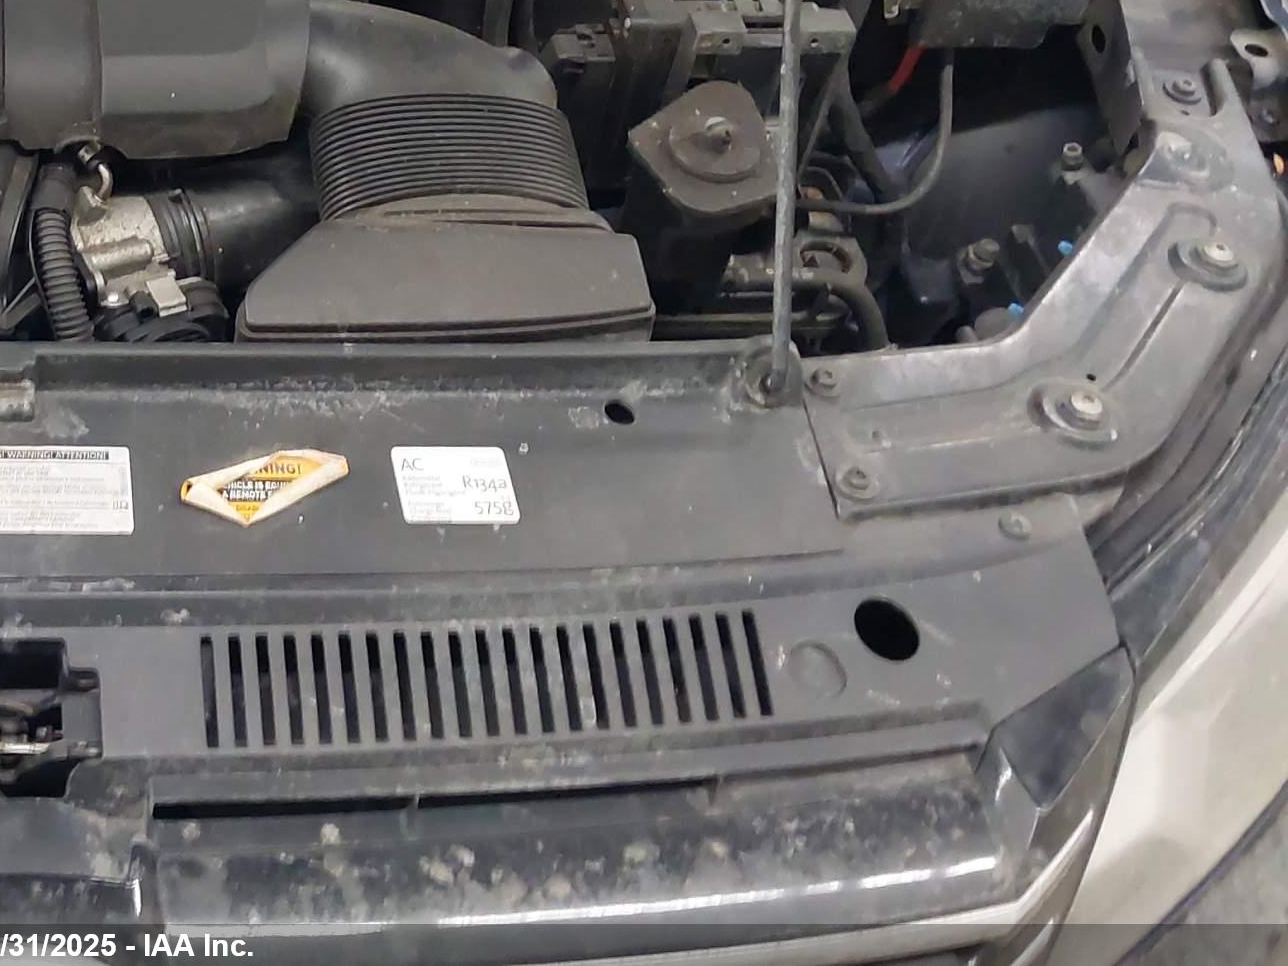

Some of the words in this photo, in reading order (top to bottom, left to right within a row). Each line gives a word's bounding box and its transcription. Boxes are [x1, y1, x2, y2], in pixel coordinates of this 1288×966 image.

[7, 450, 52, 459] WARNING!
[55, 450, 108, 459] ATTENTION!
[401, 457, 424, 471] AC
[463, 475, 507, 492] R134a
[230, 490, 267, 501] REMOTE
